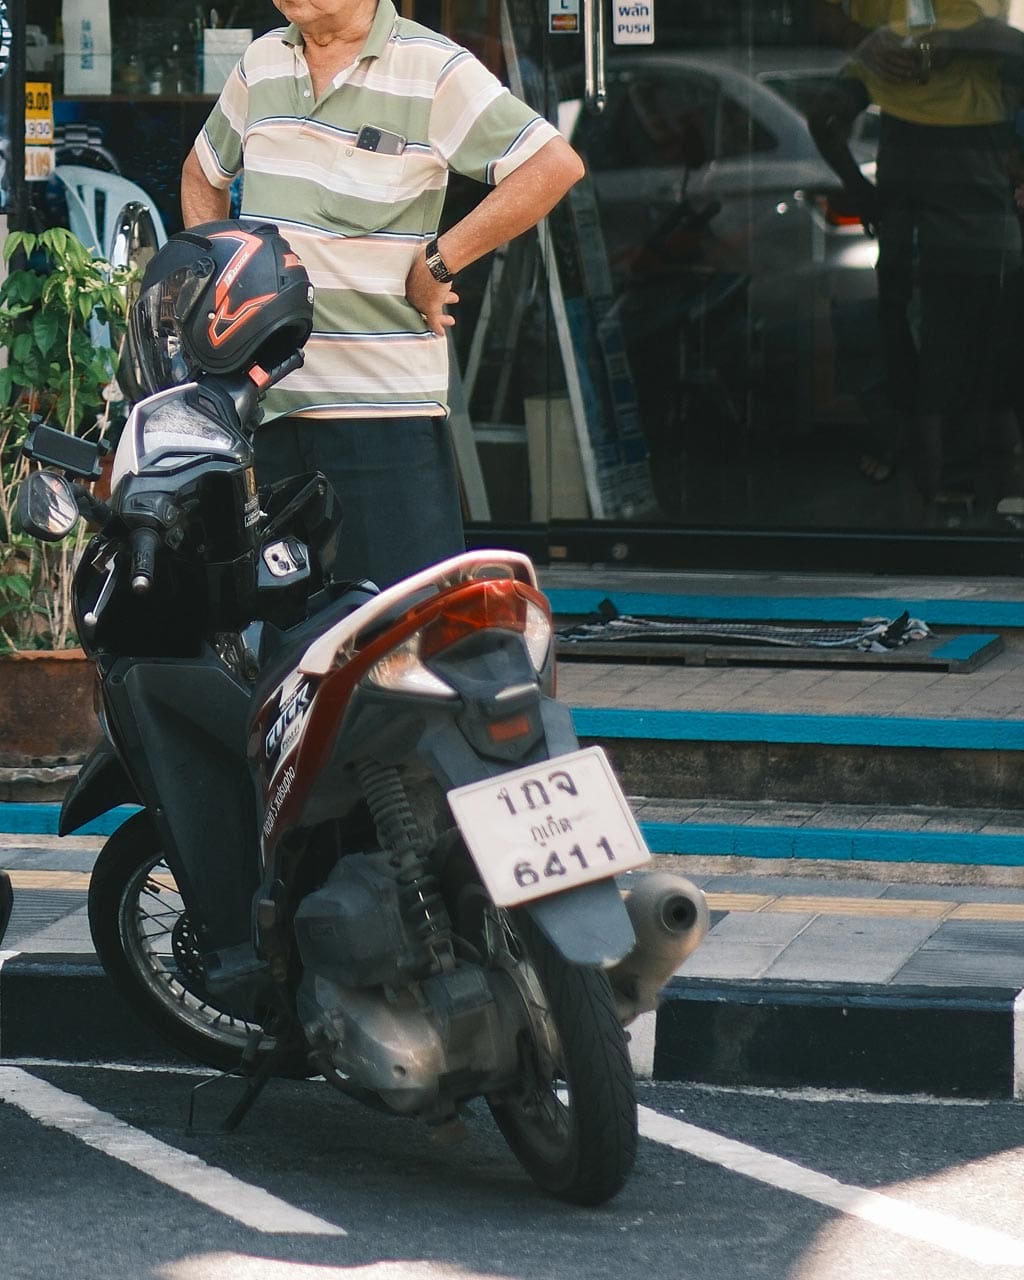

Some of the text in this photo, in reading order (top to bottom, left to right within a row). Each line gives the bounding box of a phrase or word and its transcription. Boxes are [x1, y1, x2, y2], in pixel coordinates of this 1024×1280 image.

[618, 24, 651, 33] PUSH
[265, 682, 310, 759] CLICK
[497, 770, 579, 816] 1กจ
[514, 835, 616, 888] 6411
